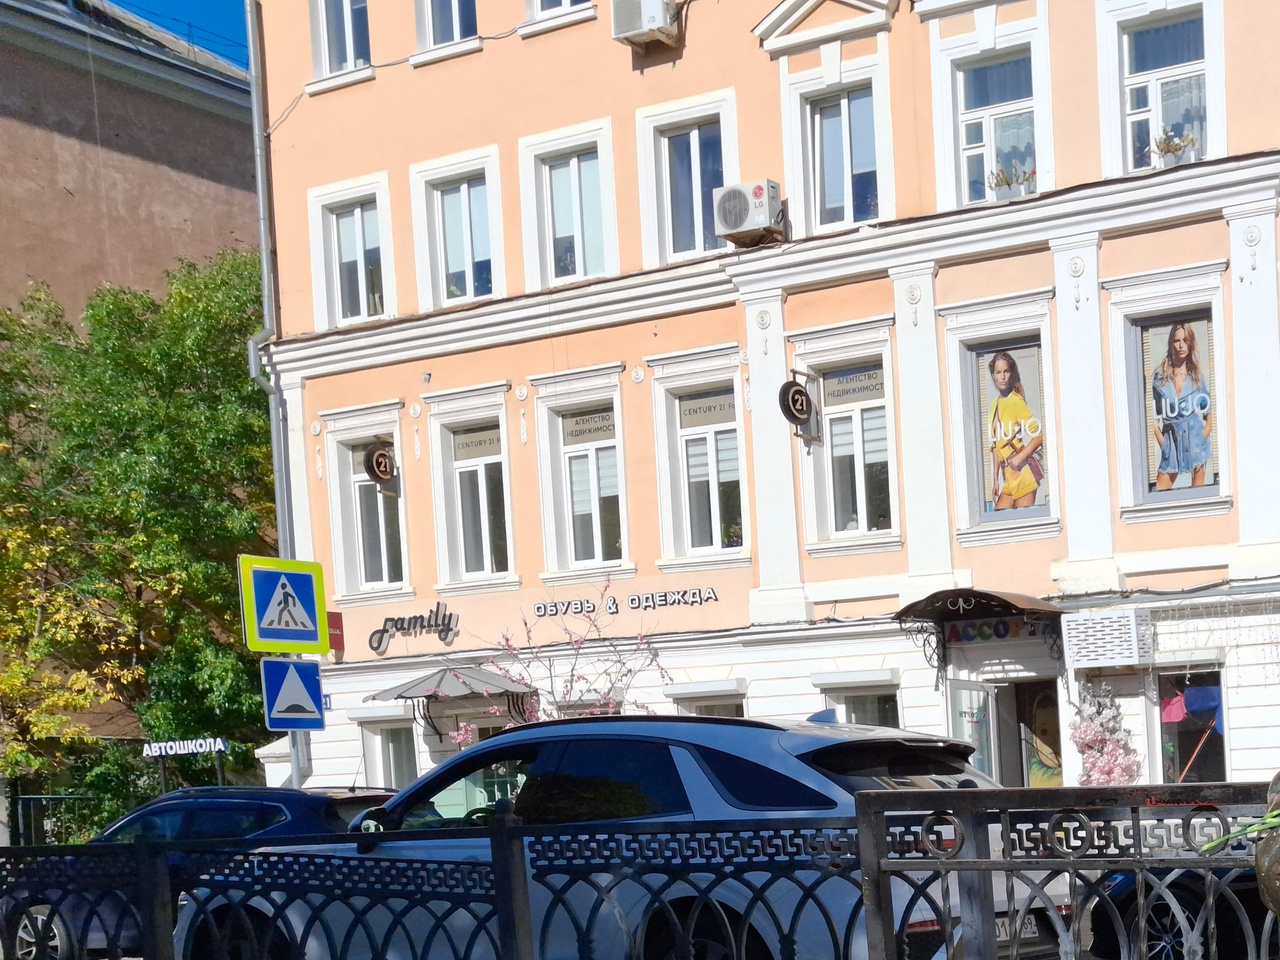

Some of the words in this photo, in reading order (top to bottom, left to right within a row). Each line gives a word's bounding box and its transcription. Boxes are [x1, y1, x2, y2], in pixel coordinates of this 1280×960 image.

[837, 372, 878, 385] АГЕНТСТВО
[683, 404, 717, 416] CENTURY
[719, 403, 725, 411] 21
[575, 414, 610, 426] АГЕНТСТВО
[457, 438, 487, 449] CENTURY
[488, 437, 494, 445] 21
[534, 600, 595, 617] ОБУВЬ
[606, 596, 618, 614] &
[628, 587, 717, 610] ОДЕЖДА
[369, 601, 459, 653] Family
[142, 738, 225, 757] АВТОШКОЛА
